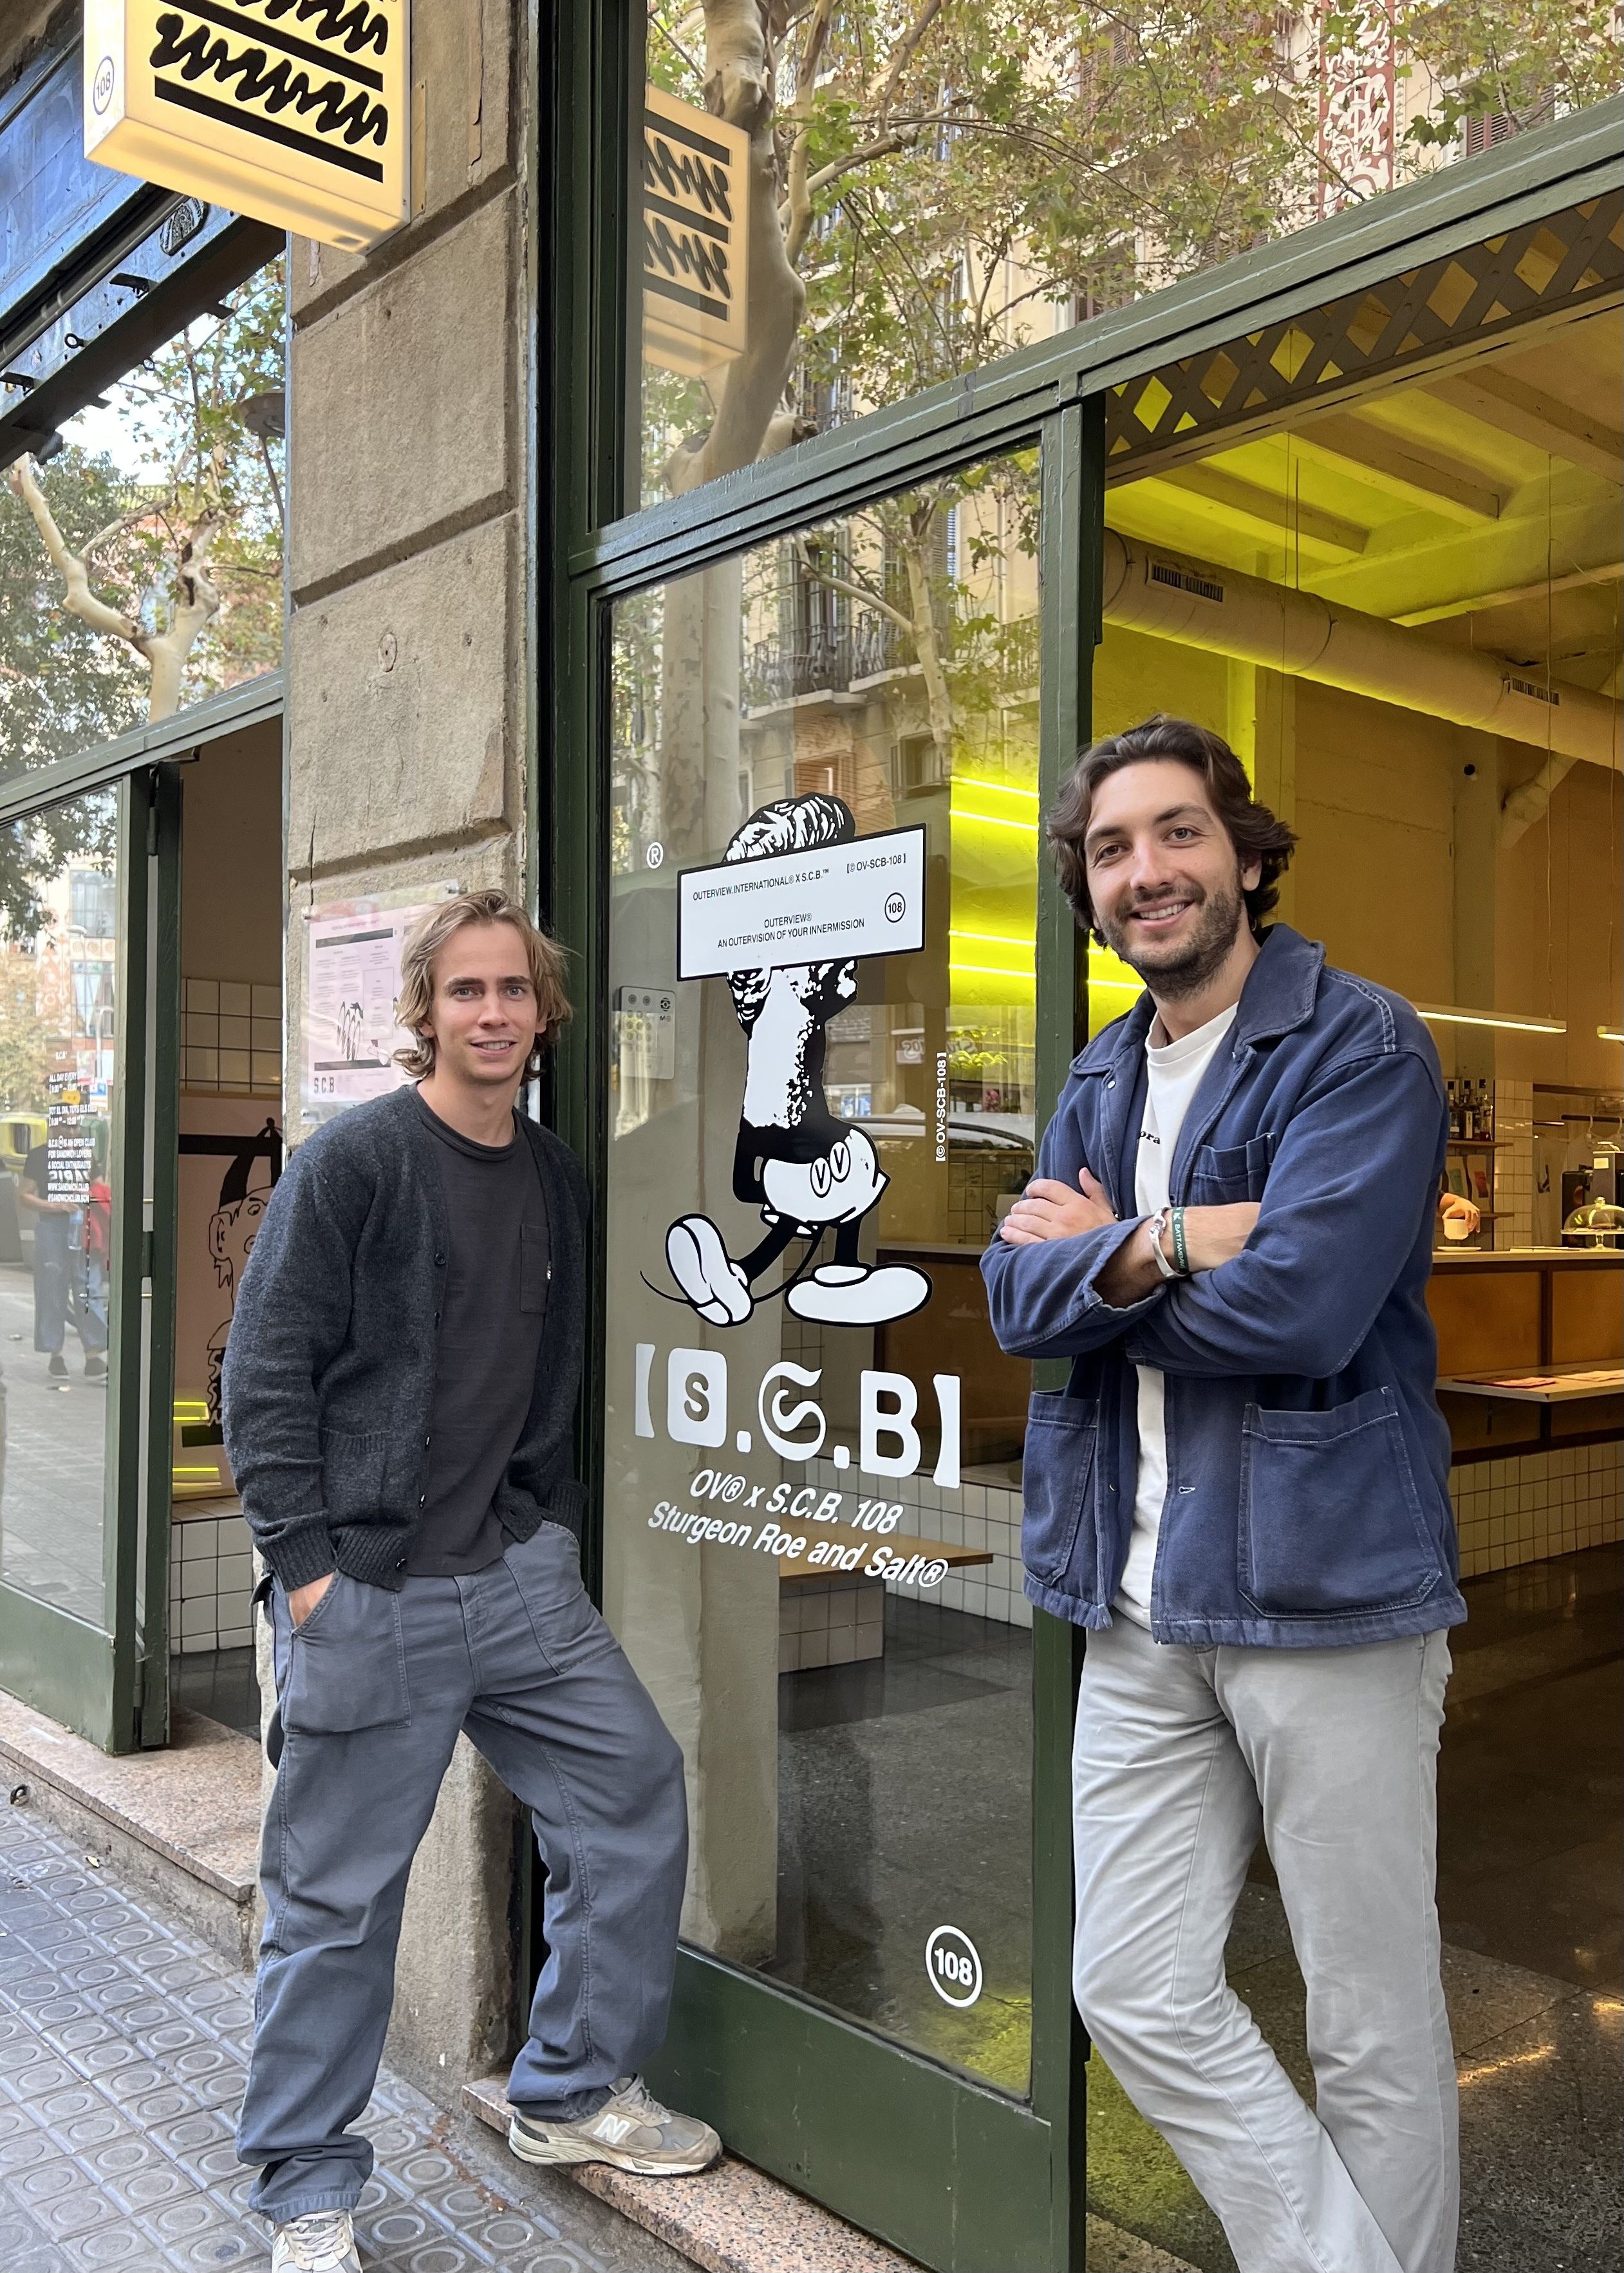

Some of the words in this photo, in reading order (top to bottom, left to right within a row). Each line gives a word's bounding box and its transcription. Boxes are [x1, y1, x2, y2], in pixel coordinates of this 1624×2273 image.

[96, 71, 111, 100] 108
[888, 901, 902, 913] 108
[718, 938, 727, 948] AN
[729, 932, 775, 947] OUTERVISION
[776, 930, 786, 940] OF
[787, 927, 808, 938] YOUR
[810, 918, 864, 935] INNERMISSION
[765, 1483, 843, 1524] S.C.B.
[850, 1499, 904, 1535] 108
[648, 1501, 752, 1547] Sturgeon
[752, 1522, 807, 1558] Roe
[807, 1540, 869, 1571] and
[933, 1947, 973, 1987] 108
